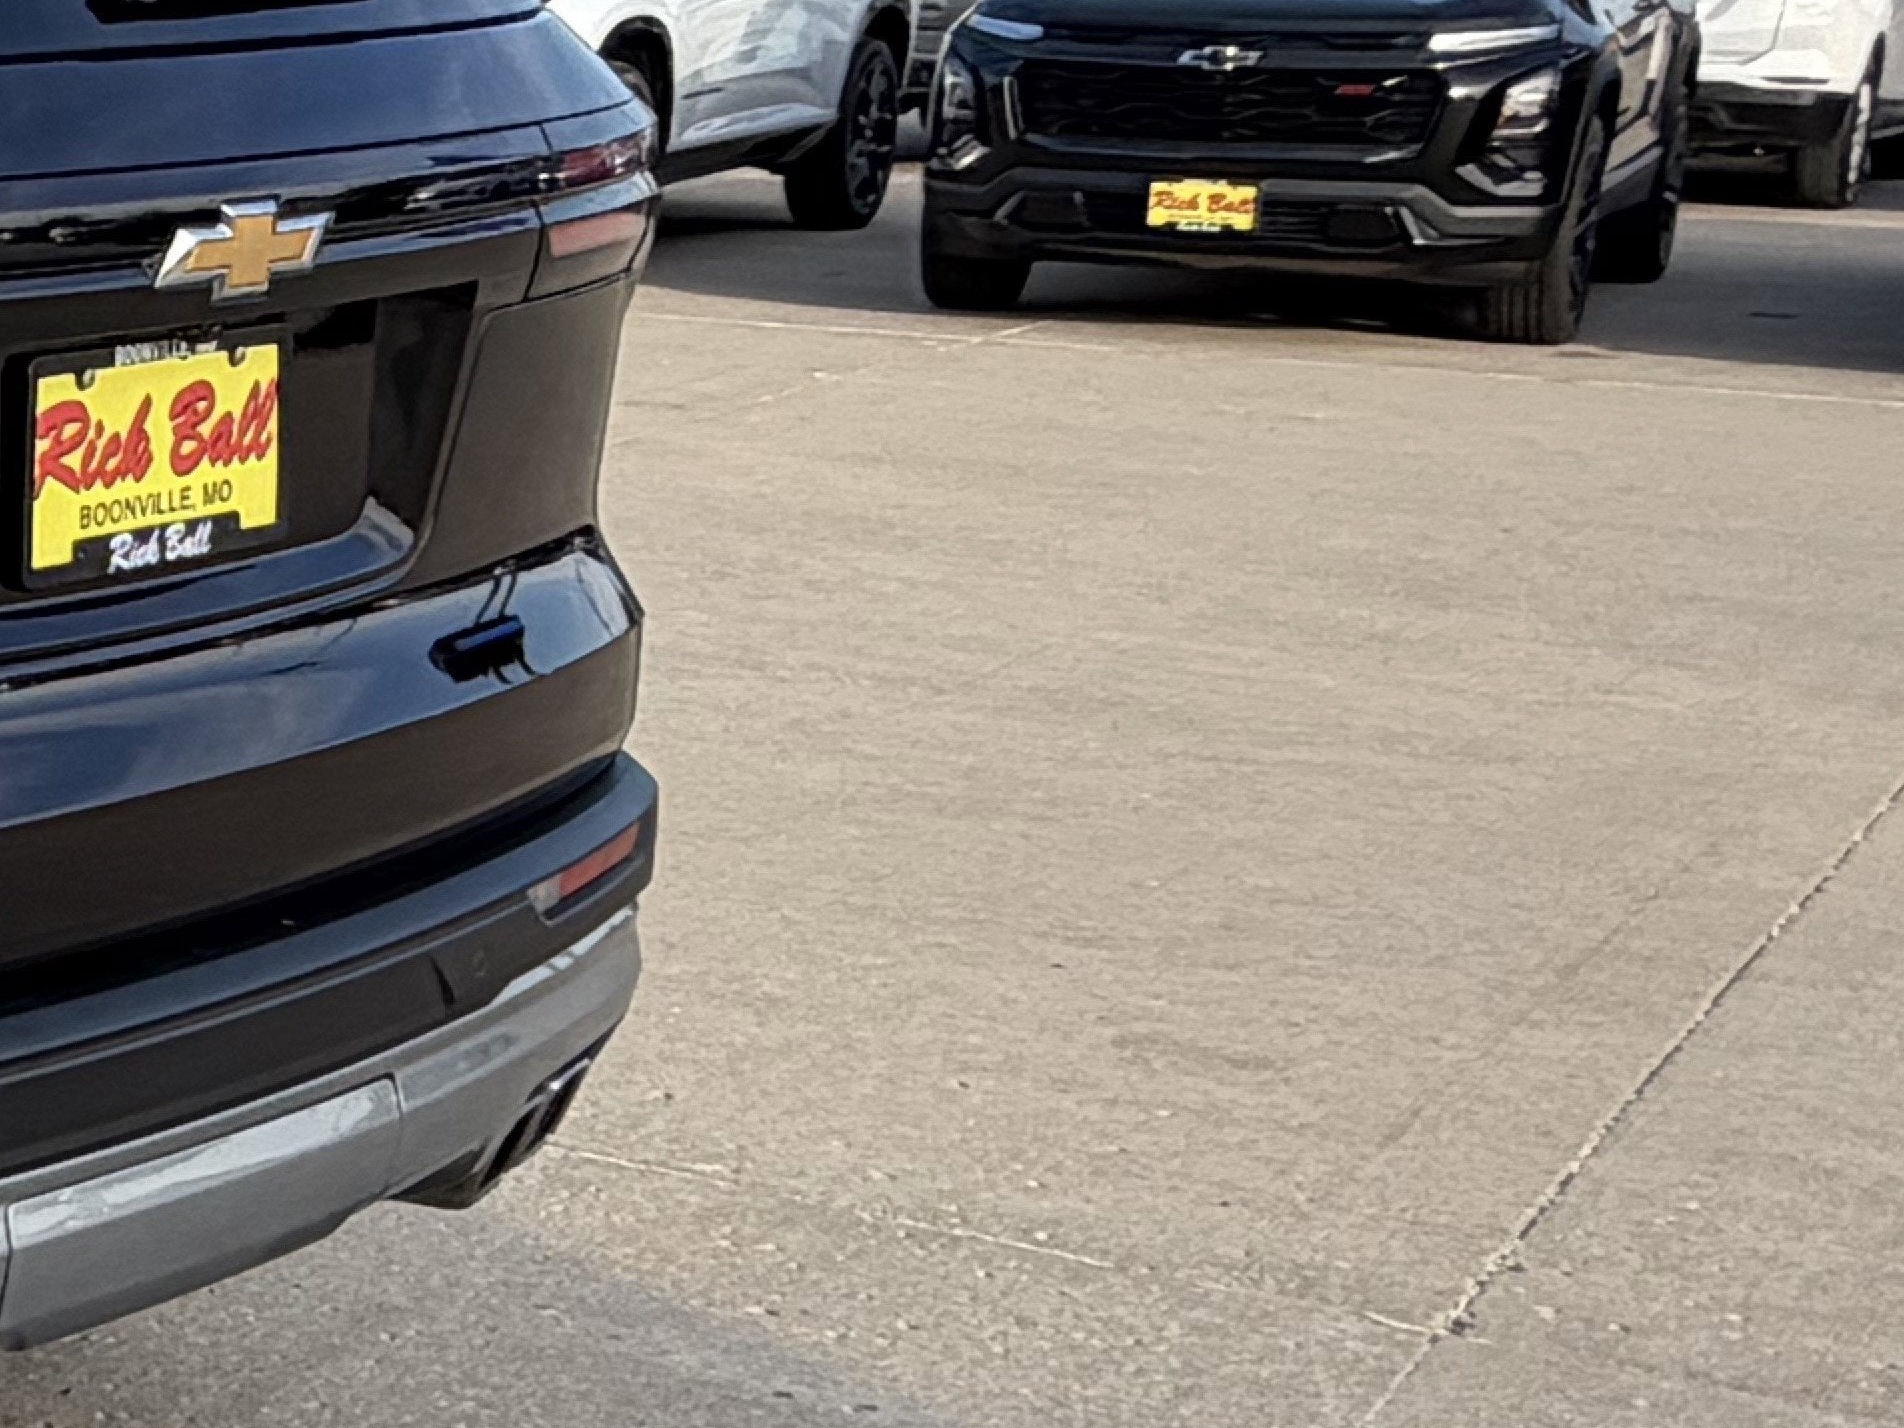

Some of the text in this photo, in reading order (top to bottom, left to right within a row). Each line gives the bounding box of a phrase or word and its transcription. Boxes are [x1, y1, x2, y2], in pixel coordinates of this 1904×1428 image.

[33, 377, 279, 500] Rick Ball
[79, 479, 233, 530] BOONVILLE, MO
[163, 520, 212, 561] Ball
